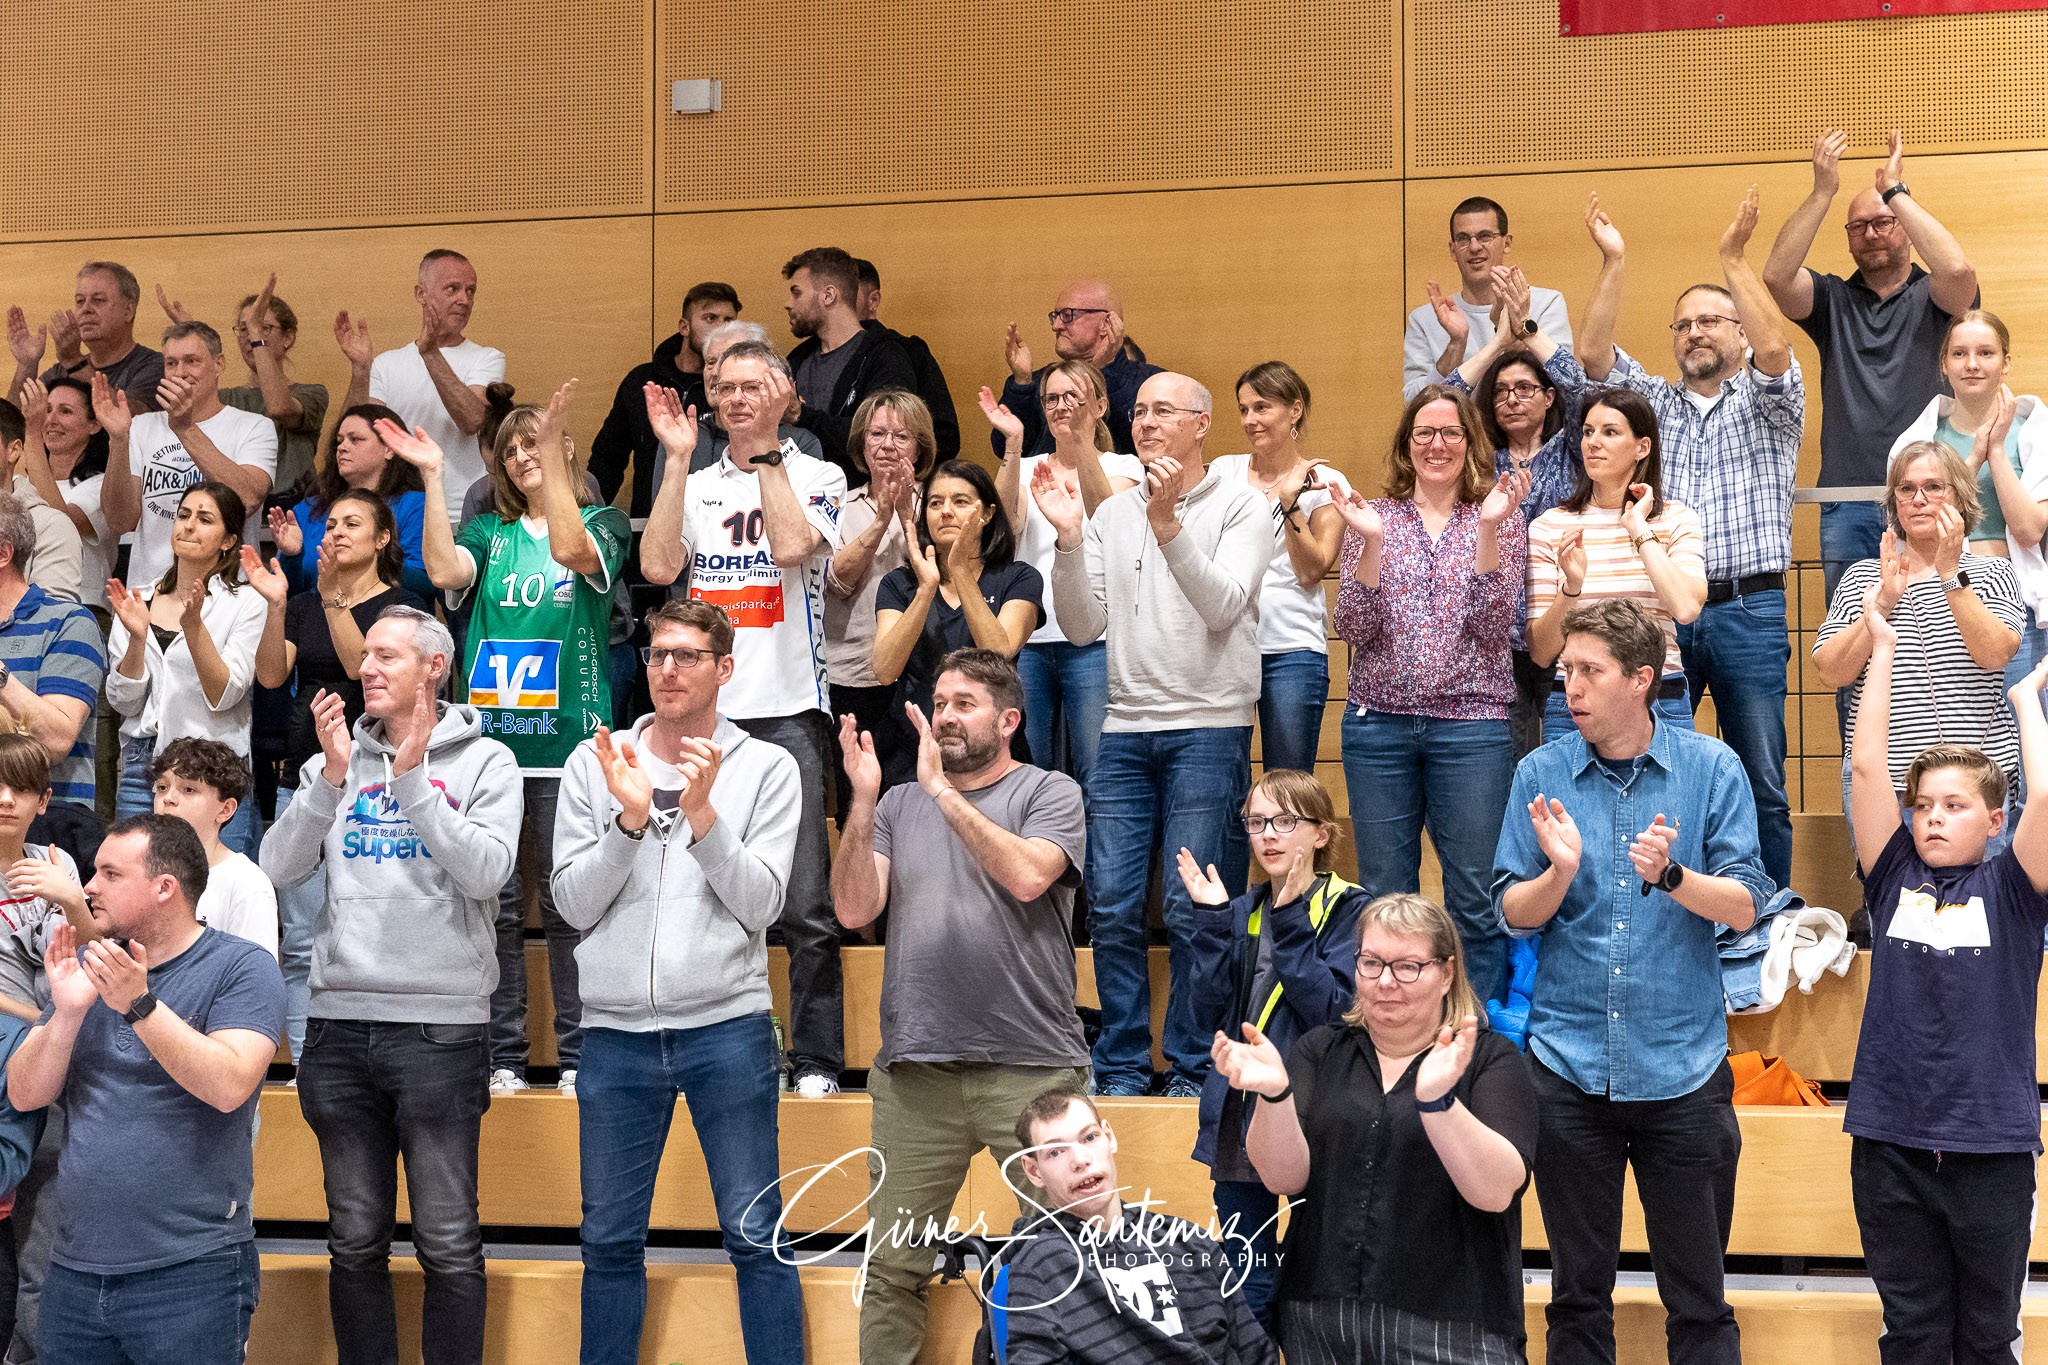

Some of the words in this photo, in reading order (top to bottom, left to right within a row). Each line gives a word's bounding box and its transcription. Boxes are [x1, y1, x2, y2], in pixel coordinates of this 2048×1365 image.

[152, 443, 182, 461] SETTING
[147, 501, 160, 515] ONE
[160, 508, 176, 520] NINE
[722, 508, 765, 548] 10
[499, 572, 546, 608] 10
[692, 572, 733, 583] energy
[577, 627, 590, 701] COBURG
[589, 627, 599, 702] AUTO-GROSCH
